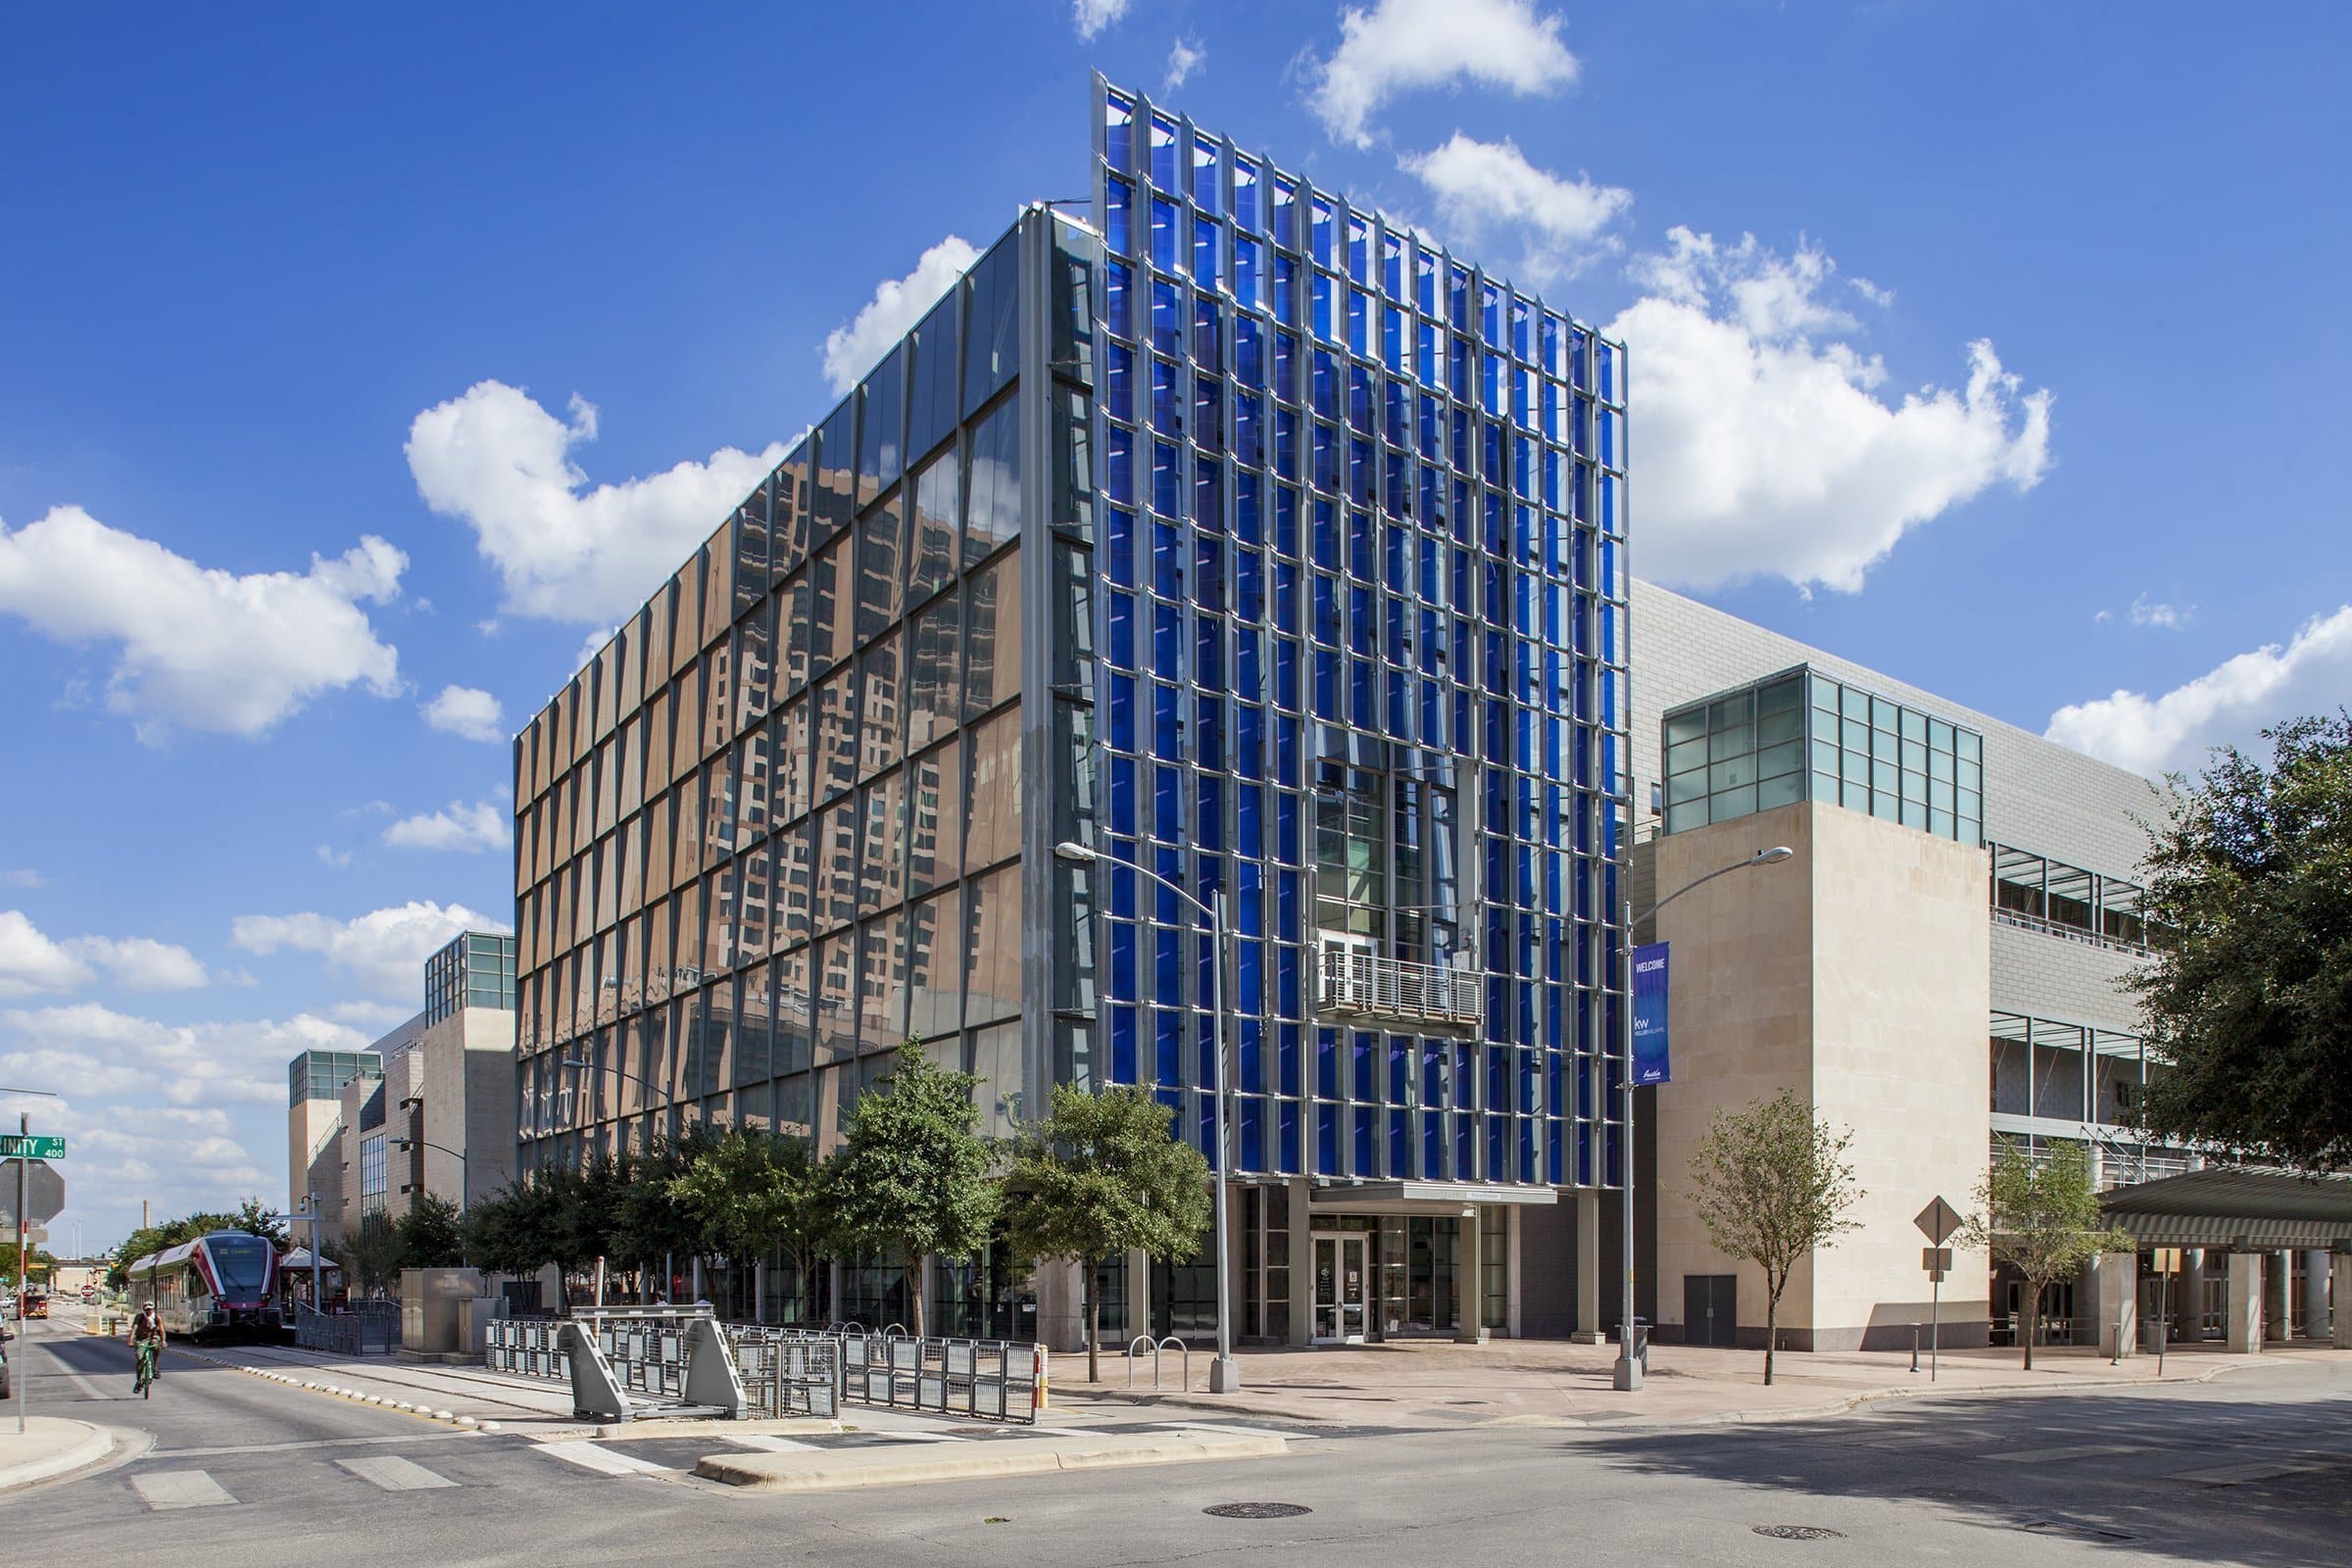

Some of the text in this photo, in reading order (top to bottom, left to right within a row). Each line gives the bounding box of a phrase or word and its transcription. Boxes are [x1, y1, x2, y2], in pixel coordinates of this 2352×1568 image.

[1637, 958, 1664, 972] WELCOME
[1635, 1015, 1648, 1030] kw
[52, 1138, 63, 1147] ST
[45, 1149, 63, 1157] 400
